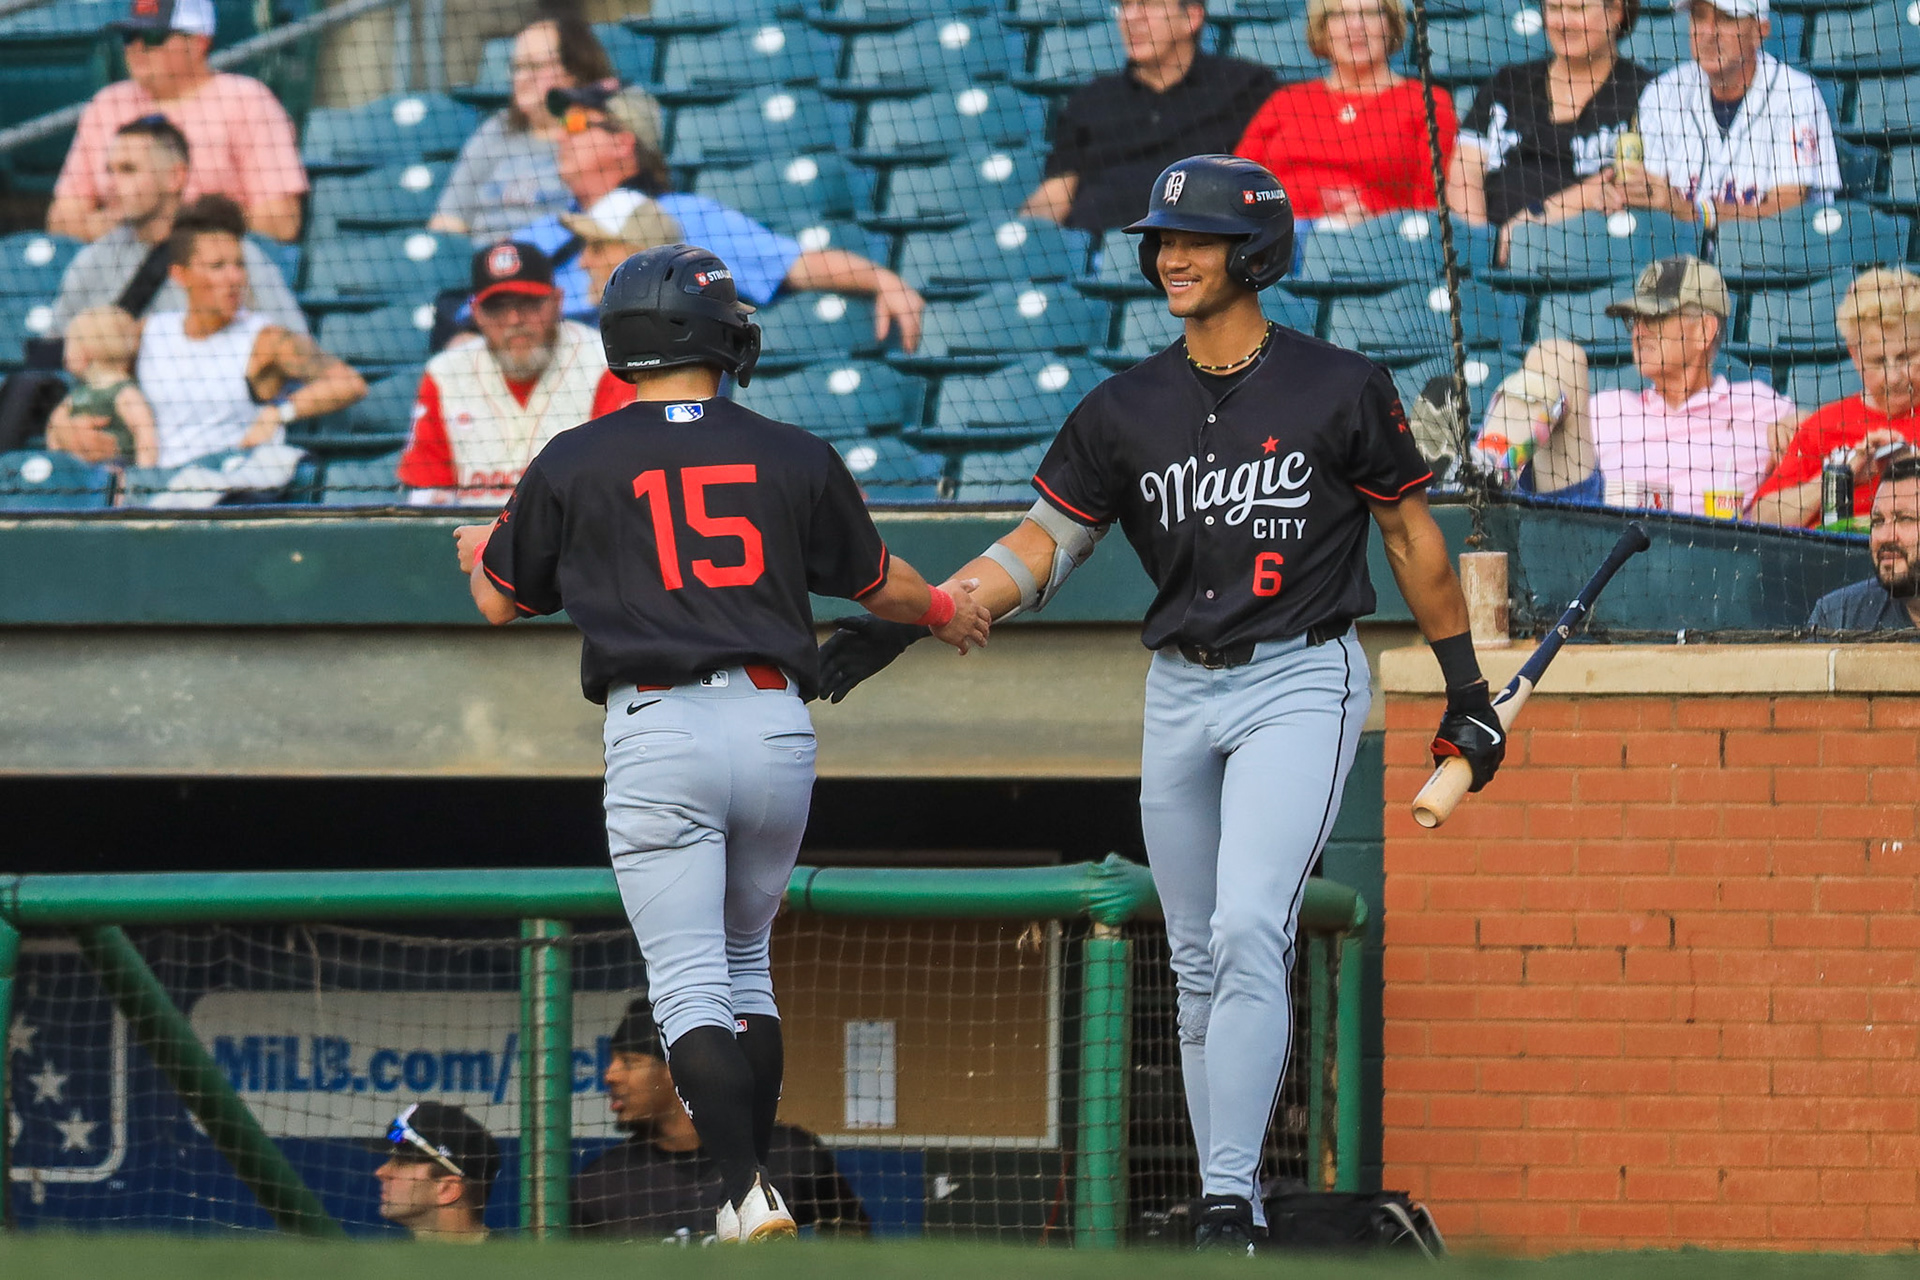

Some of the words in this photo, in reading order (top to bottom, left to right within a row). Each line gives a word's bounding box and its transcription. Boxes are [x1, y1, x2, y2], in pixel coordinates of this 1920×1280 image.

[1139, 437, 1312, 532] Magic
[632, 464, 765, 591] 15
[1253, 518, 1307, 540] CITY
[1252, 551, 1284, 597] 6
